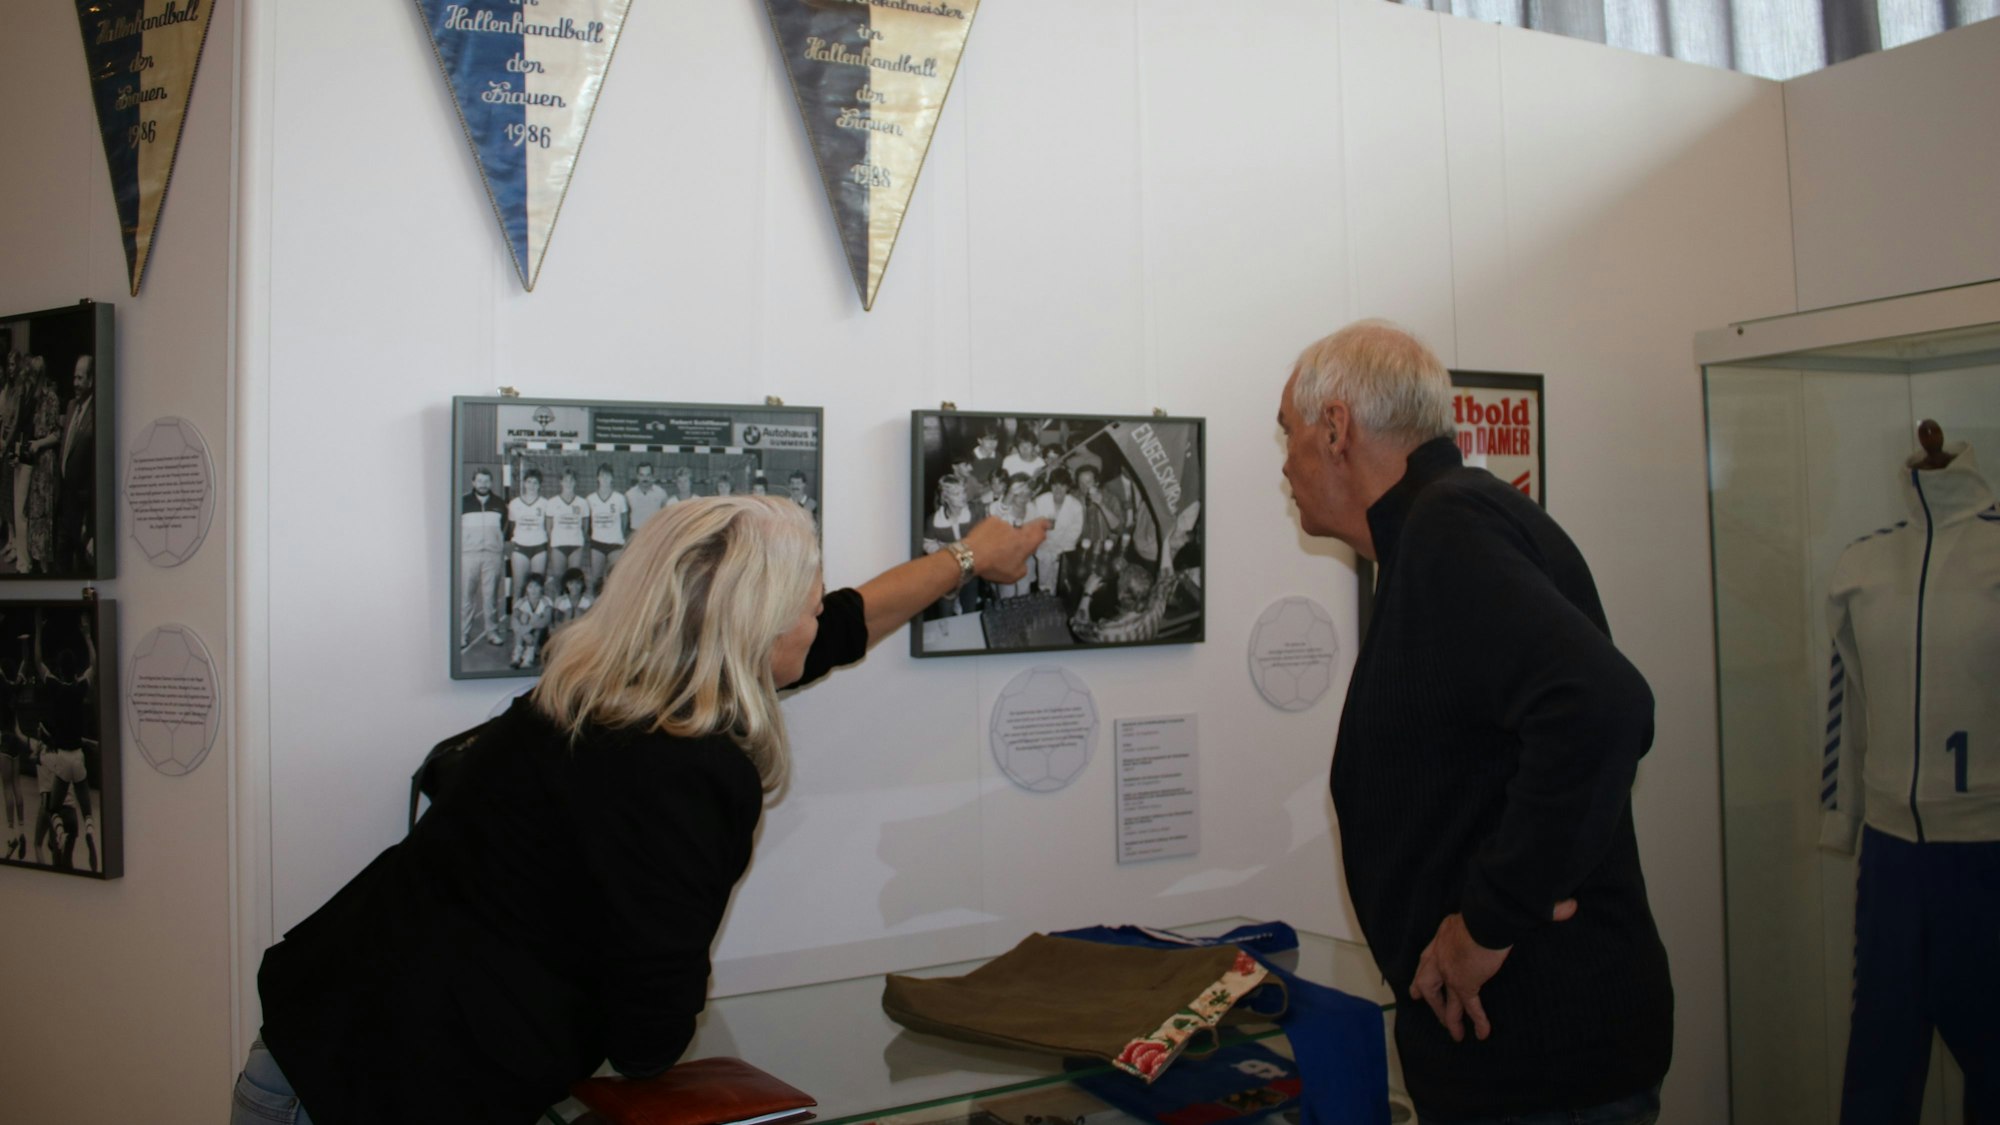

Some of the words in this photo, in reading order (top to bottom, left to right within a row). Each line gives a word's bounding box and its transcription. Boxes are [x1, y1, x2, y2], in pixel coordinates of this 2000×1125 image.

[96, 0, 199, 45] Hallenhandball
[445, 4, 604, 43] Hallenhandball
[506, 52, 545, 74] der
[804, 36, 937, 78] Hallenhandball
[481, 80, 566, 108] Frauen
[856, 84, 886, 104] der
[128, 120, 157, 149] 1986
[504, 123, 551, 149] 1986
[836, 107, 903, 136] Frauen
[762, 427, 809, 438] Autohaus
[1476, 426, 1530, 456] DAMER
[1946, 731, 1968, 793] 1
